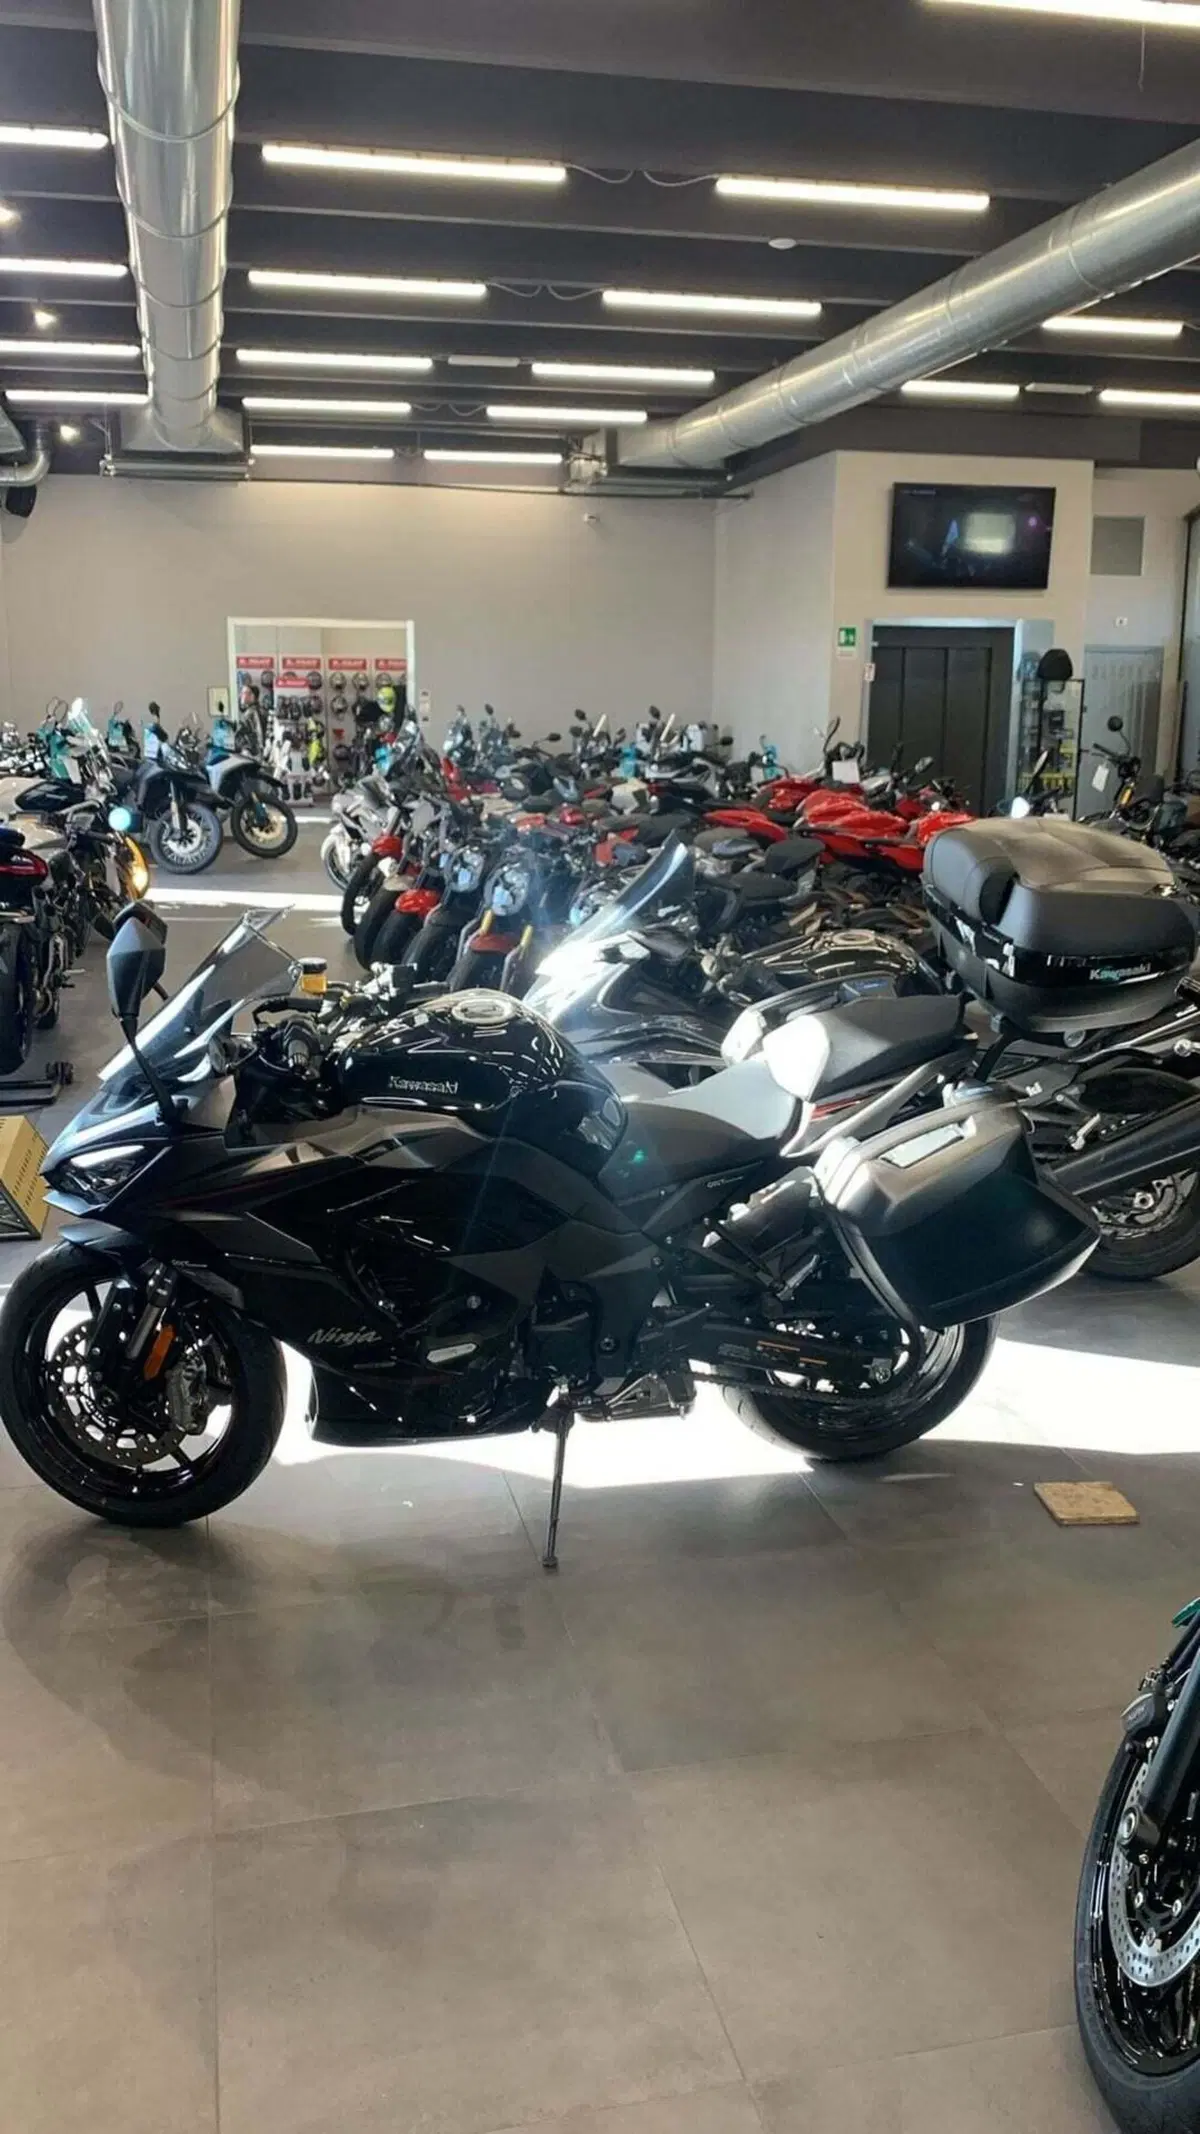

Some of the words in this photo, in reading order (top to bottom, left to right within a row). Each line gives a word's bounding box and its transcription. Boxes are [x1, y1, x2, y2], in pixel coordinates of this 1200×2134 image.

[1088, 962, 1152, 981] Kawasaki
[388, 1075, 460, 1095] Kawasaki
[306, 1325, 383, 1349] Ninja
